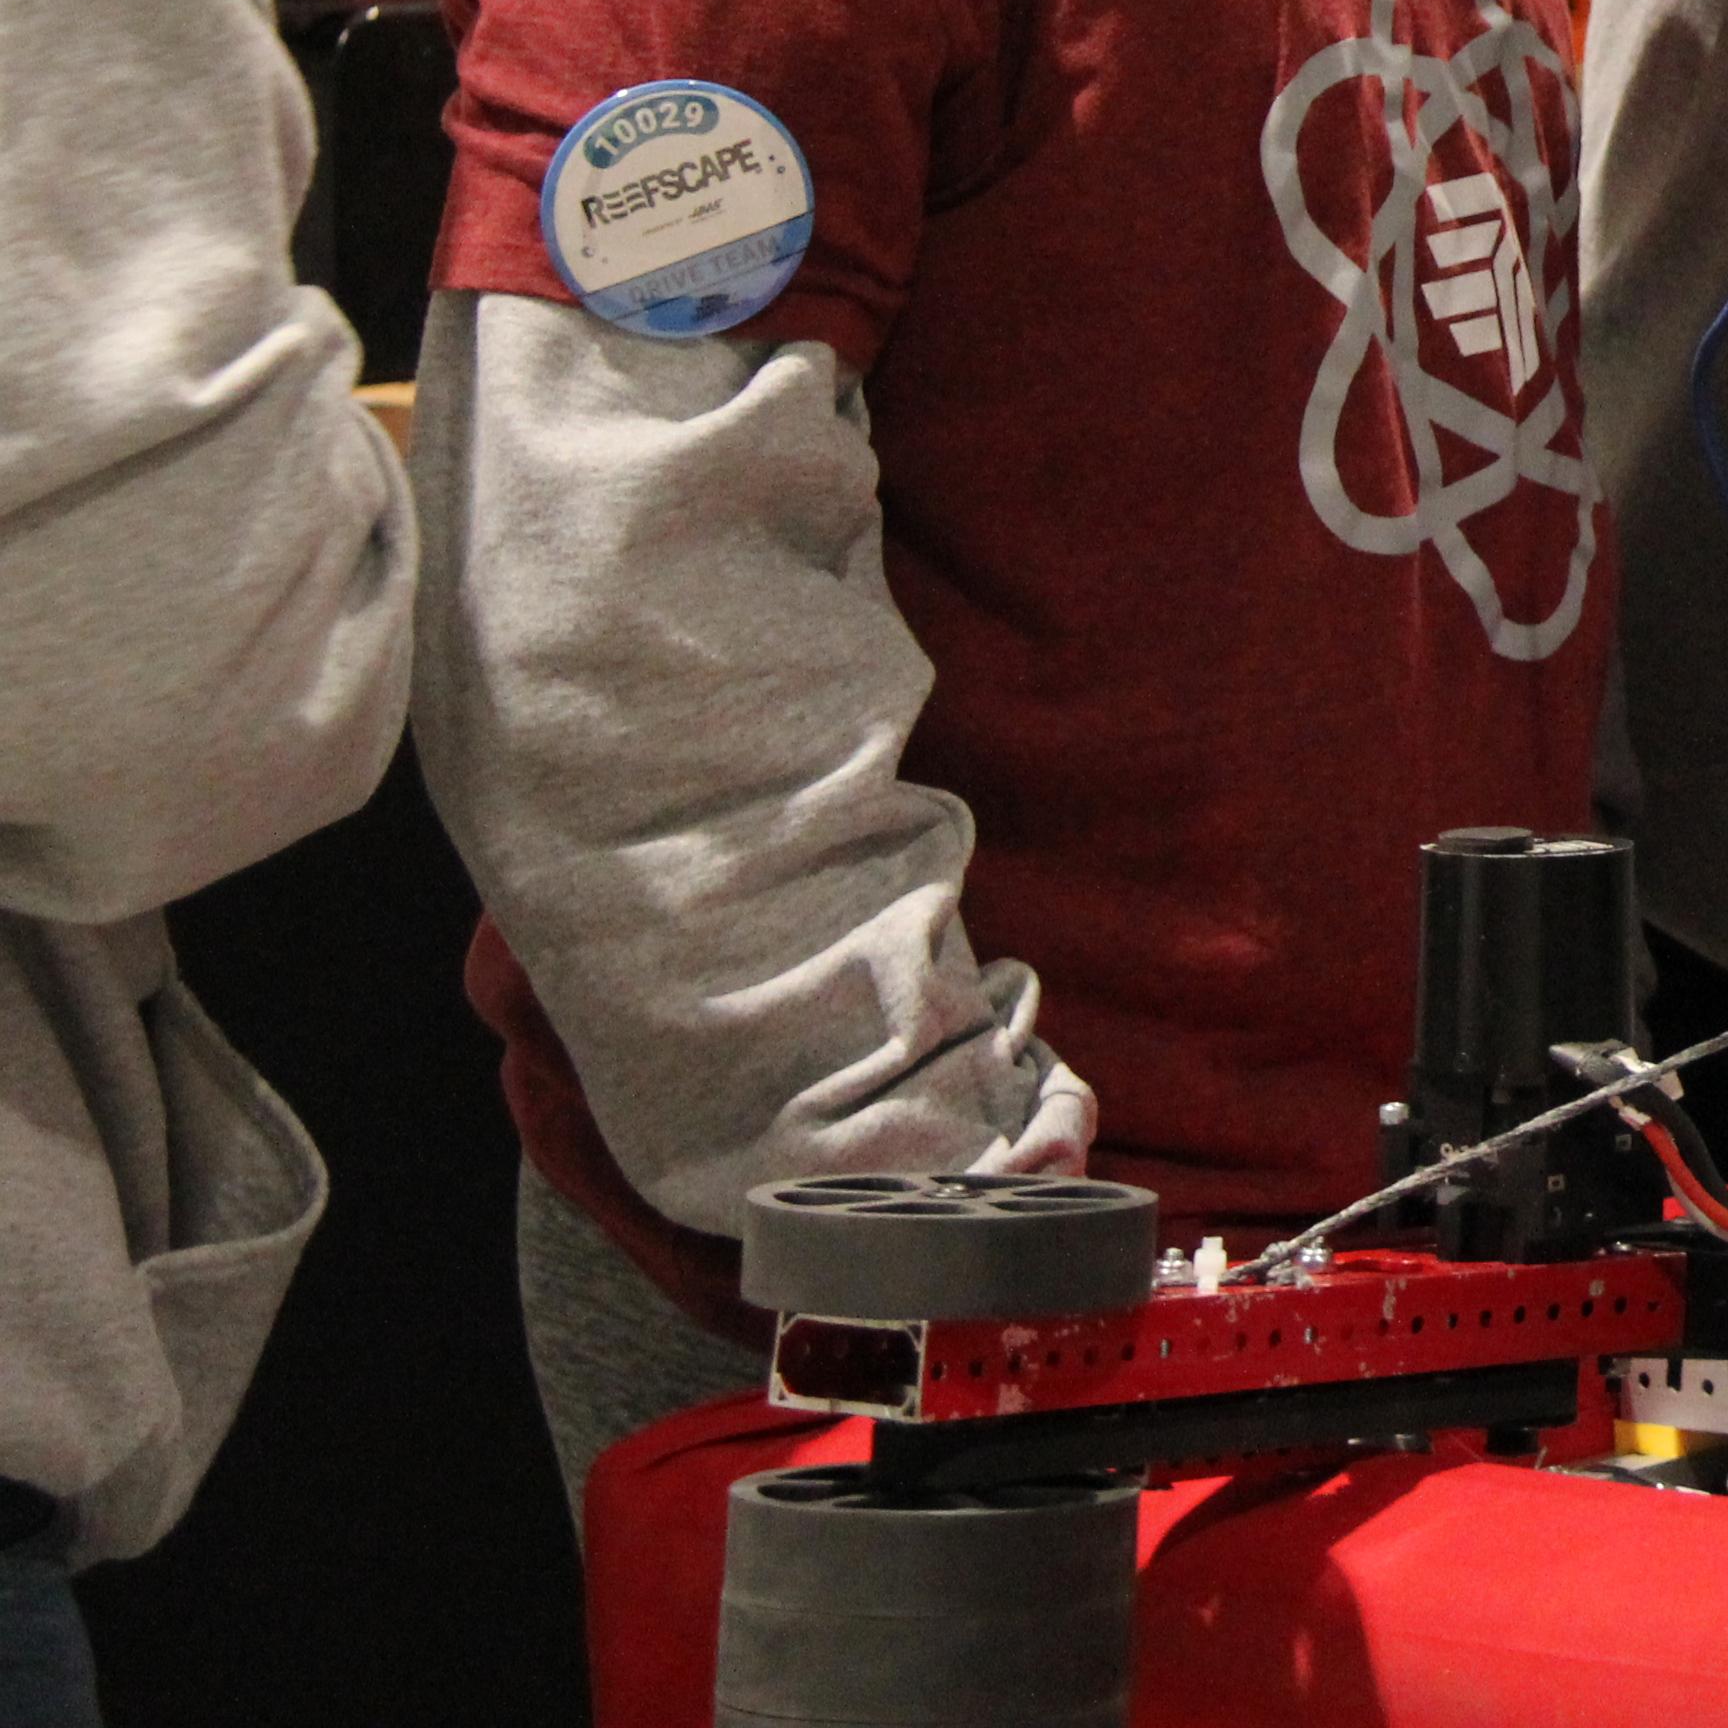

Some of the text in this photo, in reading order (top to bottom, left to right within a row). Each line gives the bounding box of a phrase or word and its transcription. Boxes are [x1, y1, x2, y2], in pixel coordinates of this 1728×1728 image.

[595, 101, 705, 158] 10029
[581, 139, 760, 229] REEFSCAPE
[630, 234, 780, 304] DRIVE TEAM
